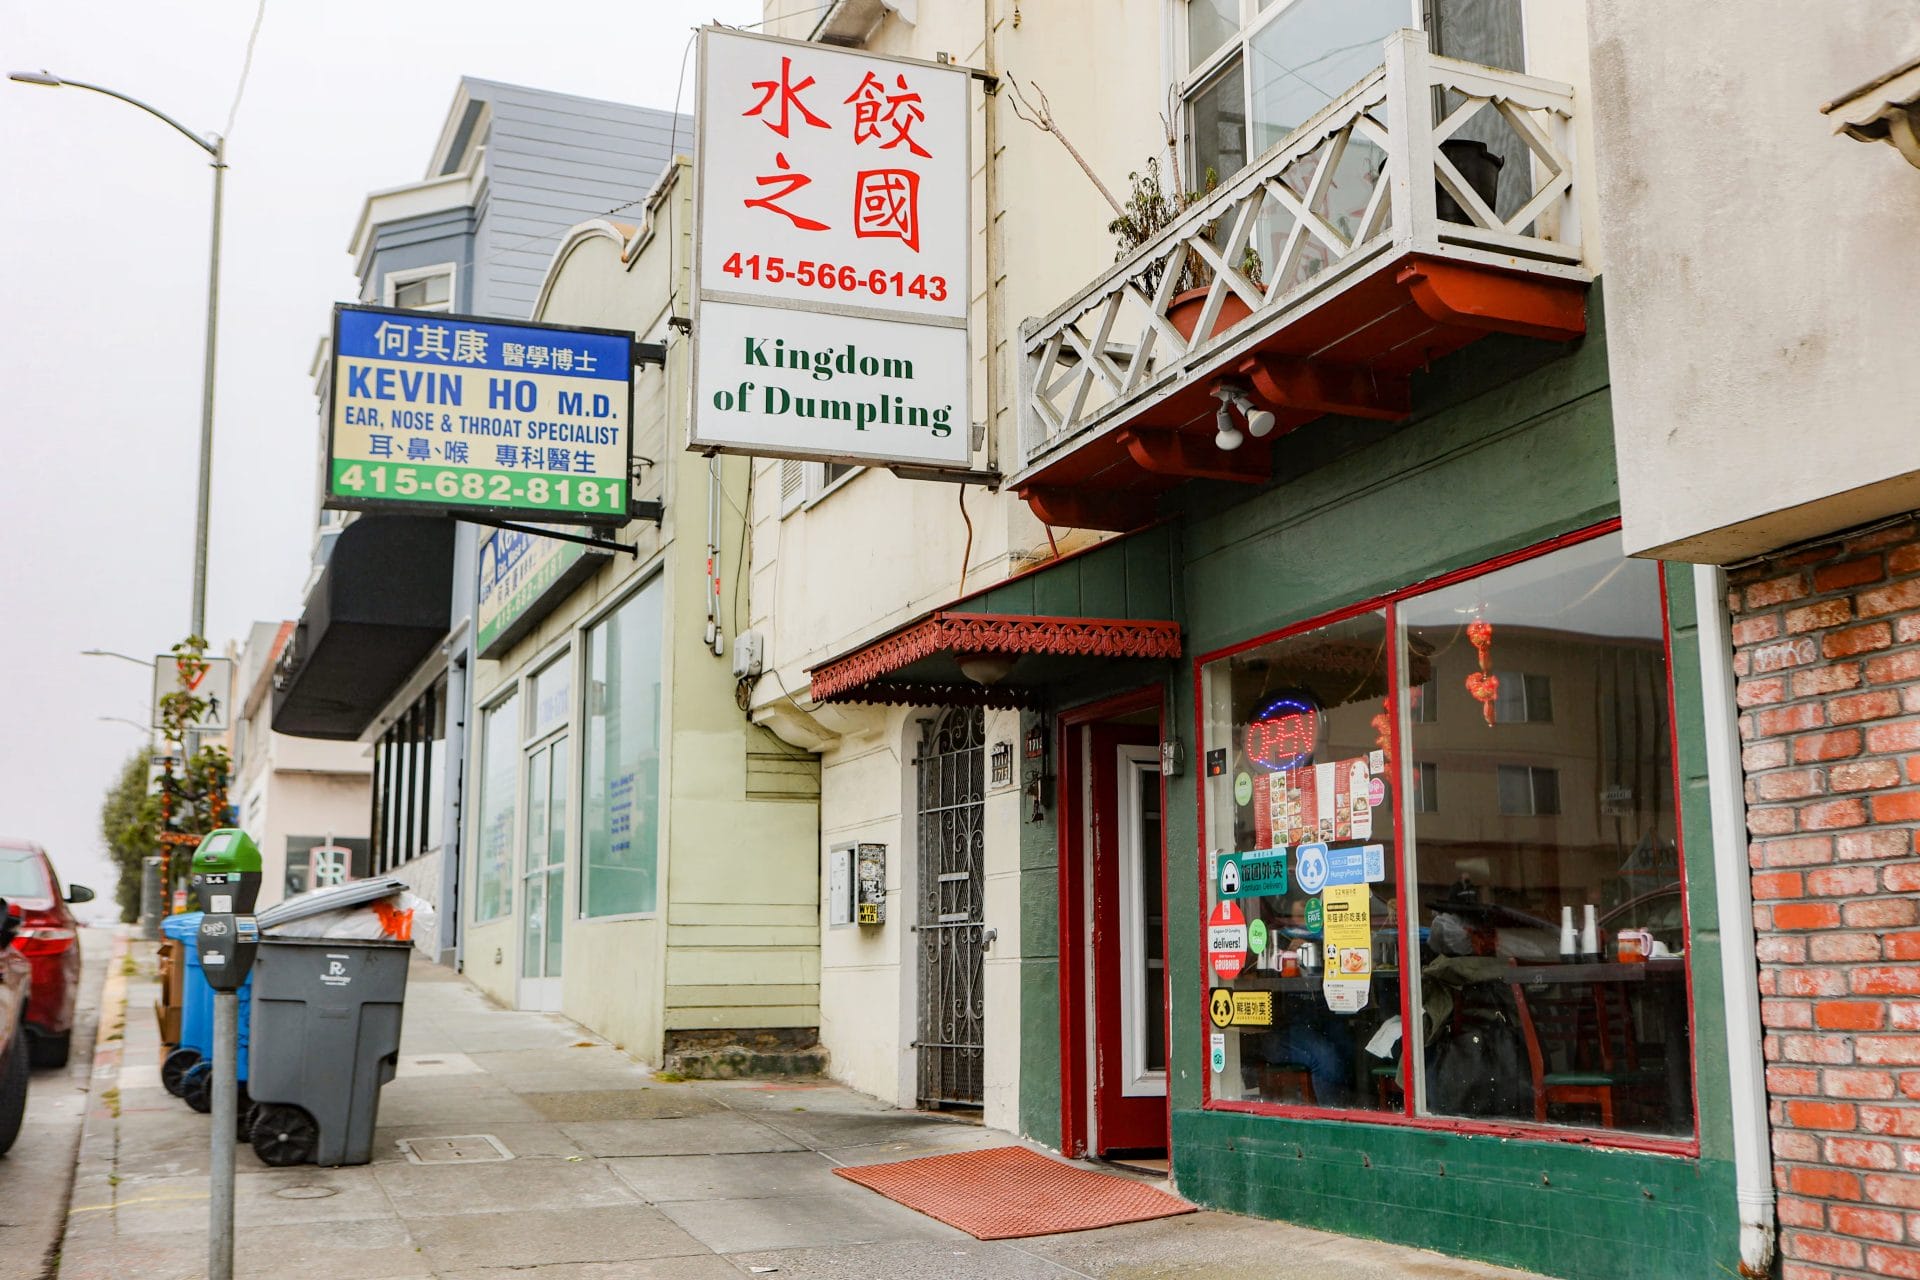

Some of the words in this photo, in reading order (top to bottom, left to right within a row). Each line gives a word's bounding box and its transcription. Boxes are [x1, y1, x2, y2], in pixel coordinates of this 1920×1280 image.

[742, 56, 932, 158] 水餃
[744, 152, 920, 253] 之國
[723, 252, 947, 302] 415-566-6143
[375, 321, 489, 365] 何其康
[502, 342, 598, 373] 醫學博士
[744, 336, 914, 381] Kingdom
[349, 365, 462, 406] KEVIN
[488, 377, 538, 413] HO
[558, 391, 617, 419] M.D.
[713, 382, 755, 413] of
[763, 386, 952, 438] Dumpling
[345, 406, 384, 430] EAR,
[392, 410, 434, 432] NOSE
[441, 414, 452, 432] &
[460, 415, 522, 440] THROAT
[527, 422, 619, 445] SPECIALIST
[496, 444, 596, 474] 專科醫生
[339, 464, 621, 509] 415-682-8181
[1248, 709, 1314, 761] OPEN
[860, 903, 876, 914] WYDE
[860, 913, 875, 922] MTA
[1213, 936, 1241, 949] delivers!
